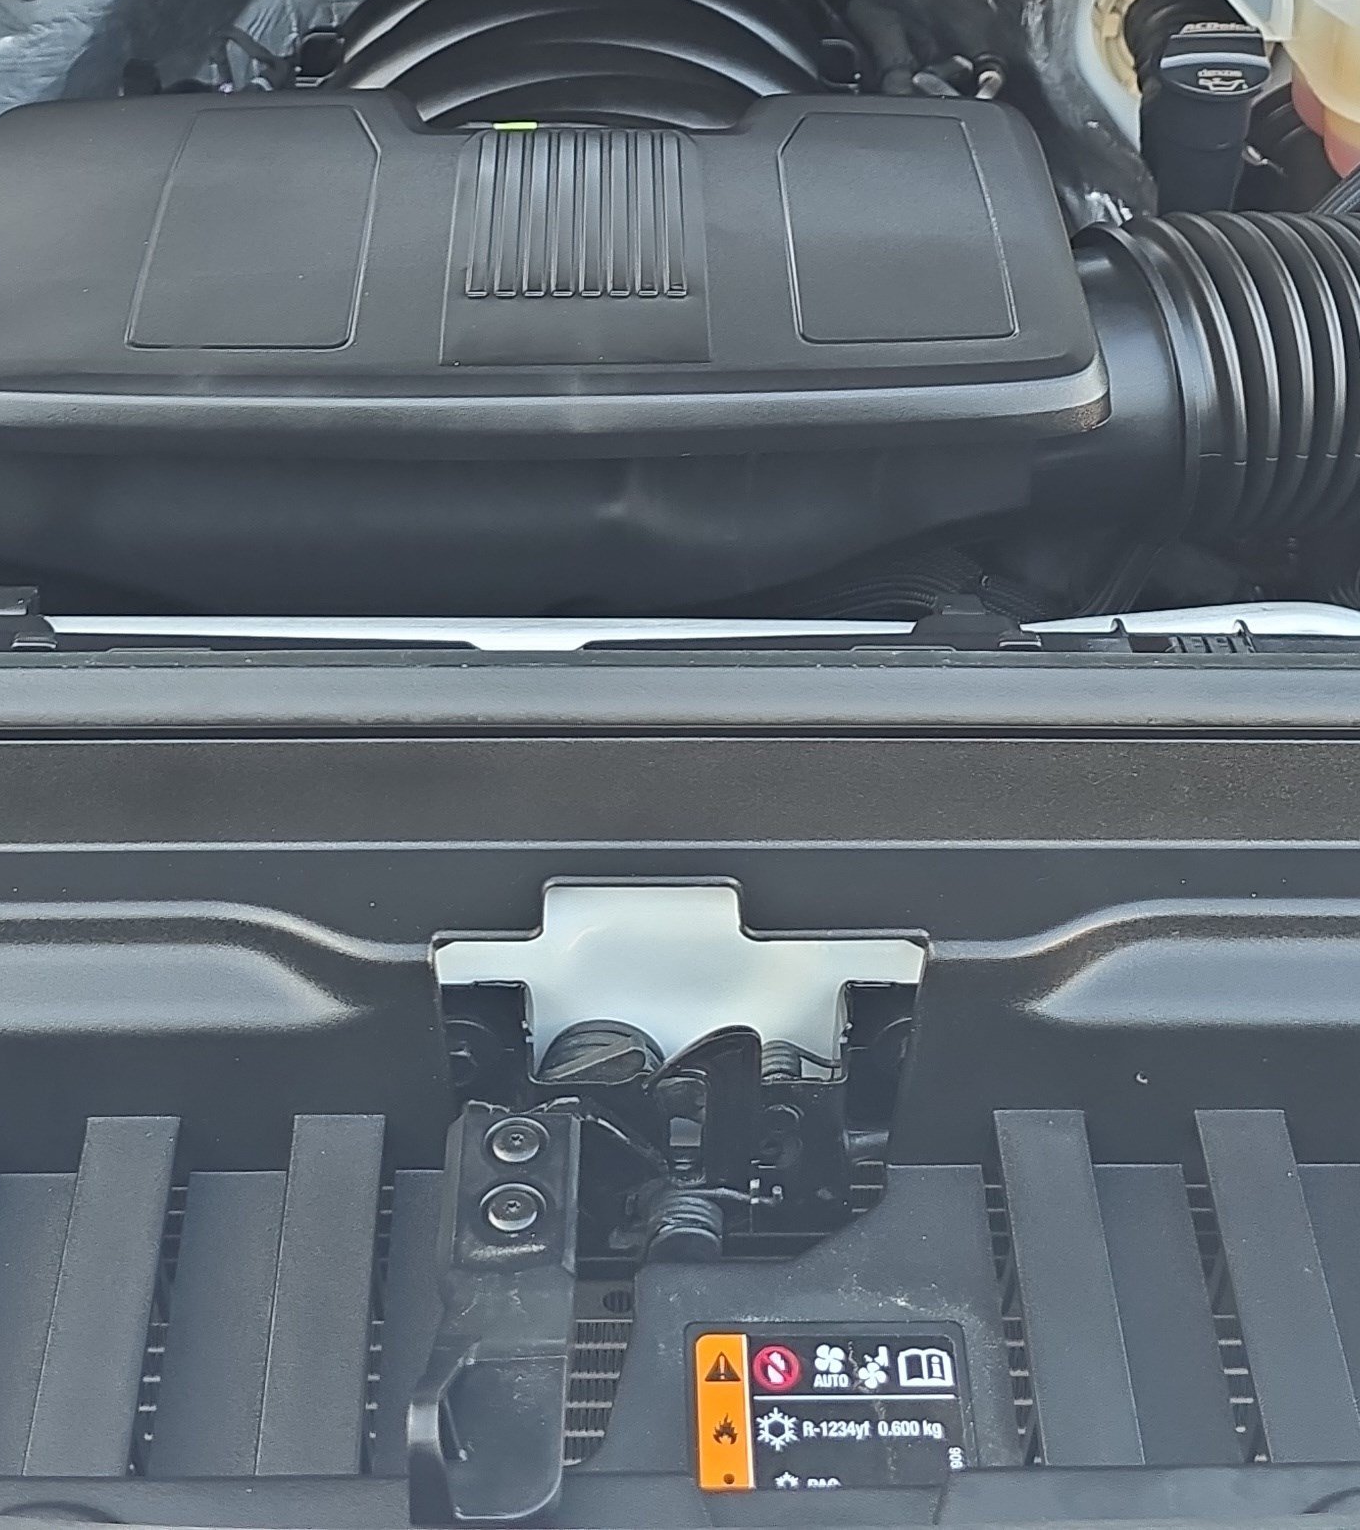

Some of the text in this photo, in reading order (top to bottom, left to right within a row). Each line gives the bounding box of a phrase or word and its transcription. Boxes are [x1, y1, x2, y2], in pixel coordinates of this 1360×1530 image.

[813, 1373, 849, 1388] AUTO
[802, 1419, 945, 1440] R-1234yf 0.600 kg
